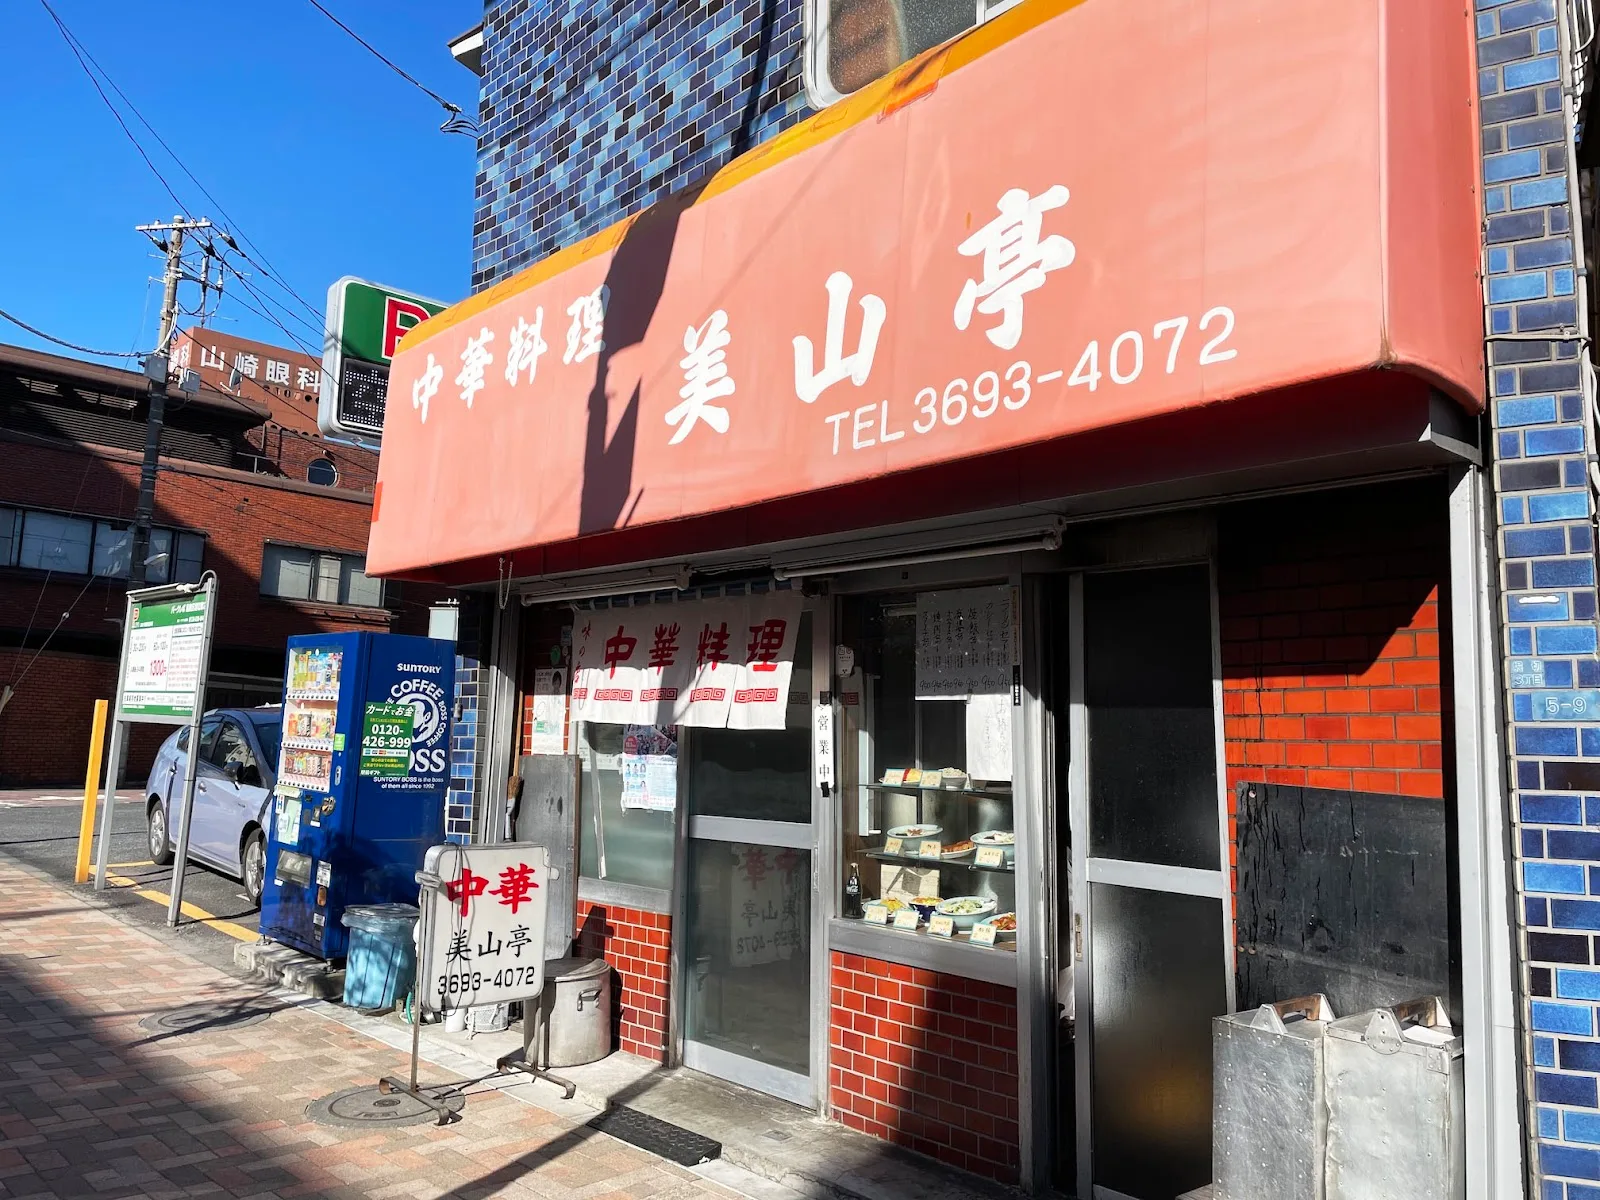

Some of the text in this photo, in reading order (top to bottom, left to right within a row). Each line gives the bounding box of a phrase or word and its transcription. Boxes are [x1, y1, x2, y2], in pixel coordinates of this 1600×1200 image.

[664, 185, 1077, 446] 美山亭
[200, 345, 321, 394] 山崎眼科
[412, 285, 611, 425] 中華料理
[826, 306, 1239, 455] TEL 3693-4072
[397, 663, 441, 674] SUNTORY
[604, 619, 787, 680] 中華料理
[366, 704, 415, 717] カードでお金
[391, 679, 445, 701] COFFEE
[1545, 696, 1587, 715] 5-9
[362, 735, 412, 749] 426-999
[371, 724, 404, 736] 0120-
[425, 700, 448, 748] BOSS COFFEE
[817, 714, 829, 778] 営業中
[445, 863, 539, 917] 中華
[445, 924, 532, 963] 美山亭
[437, 966, 535, 996] 3693-4072
